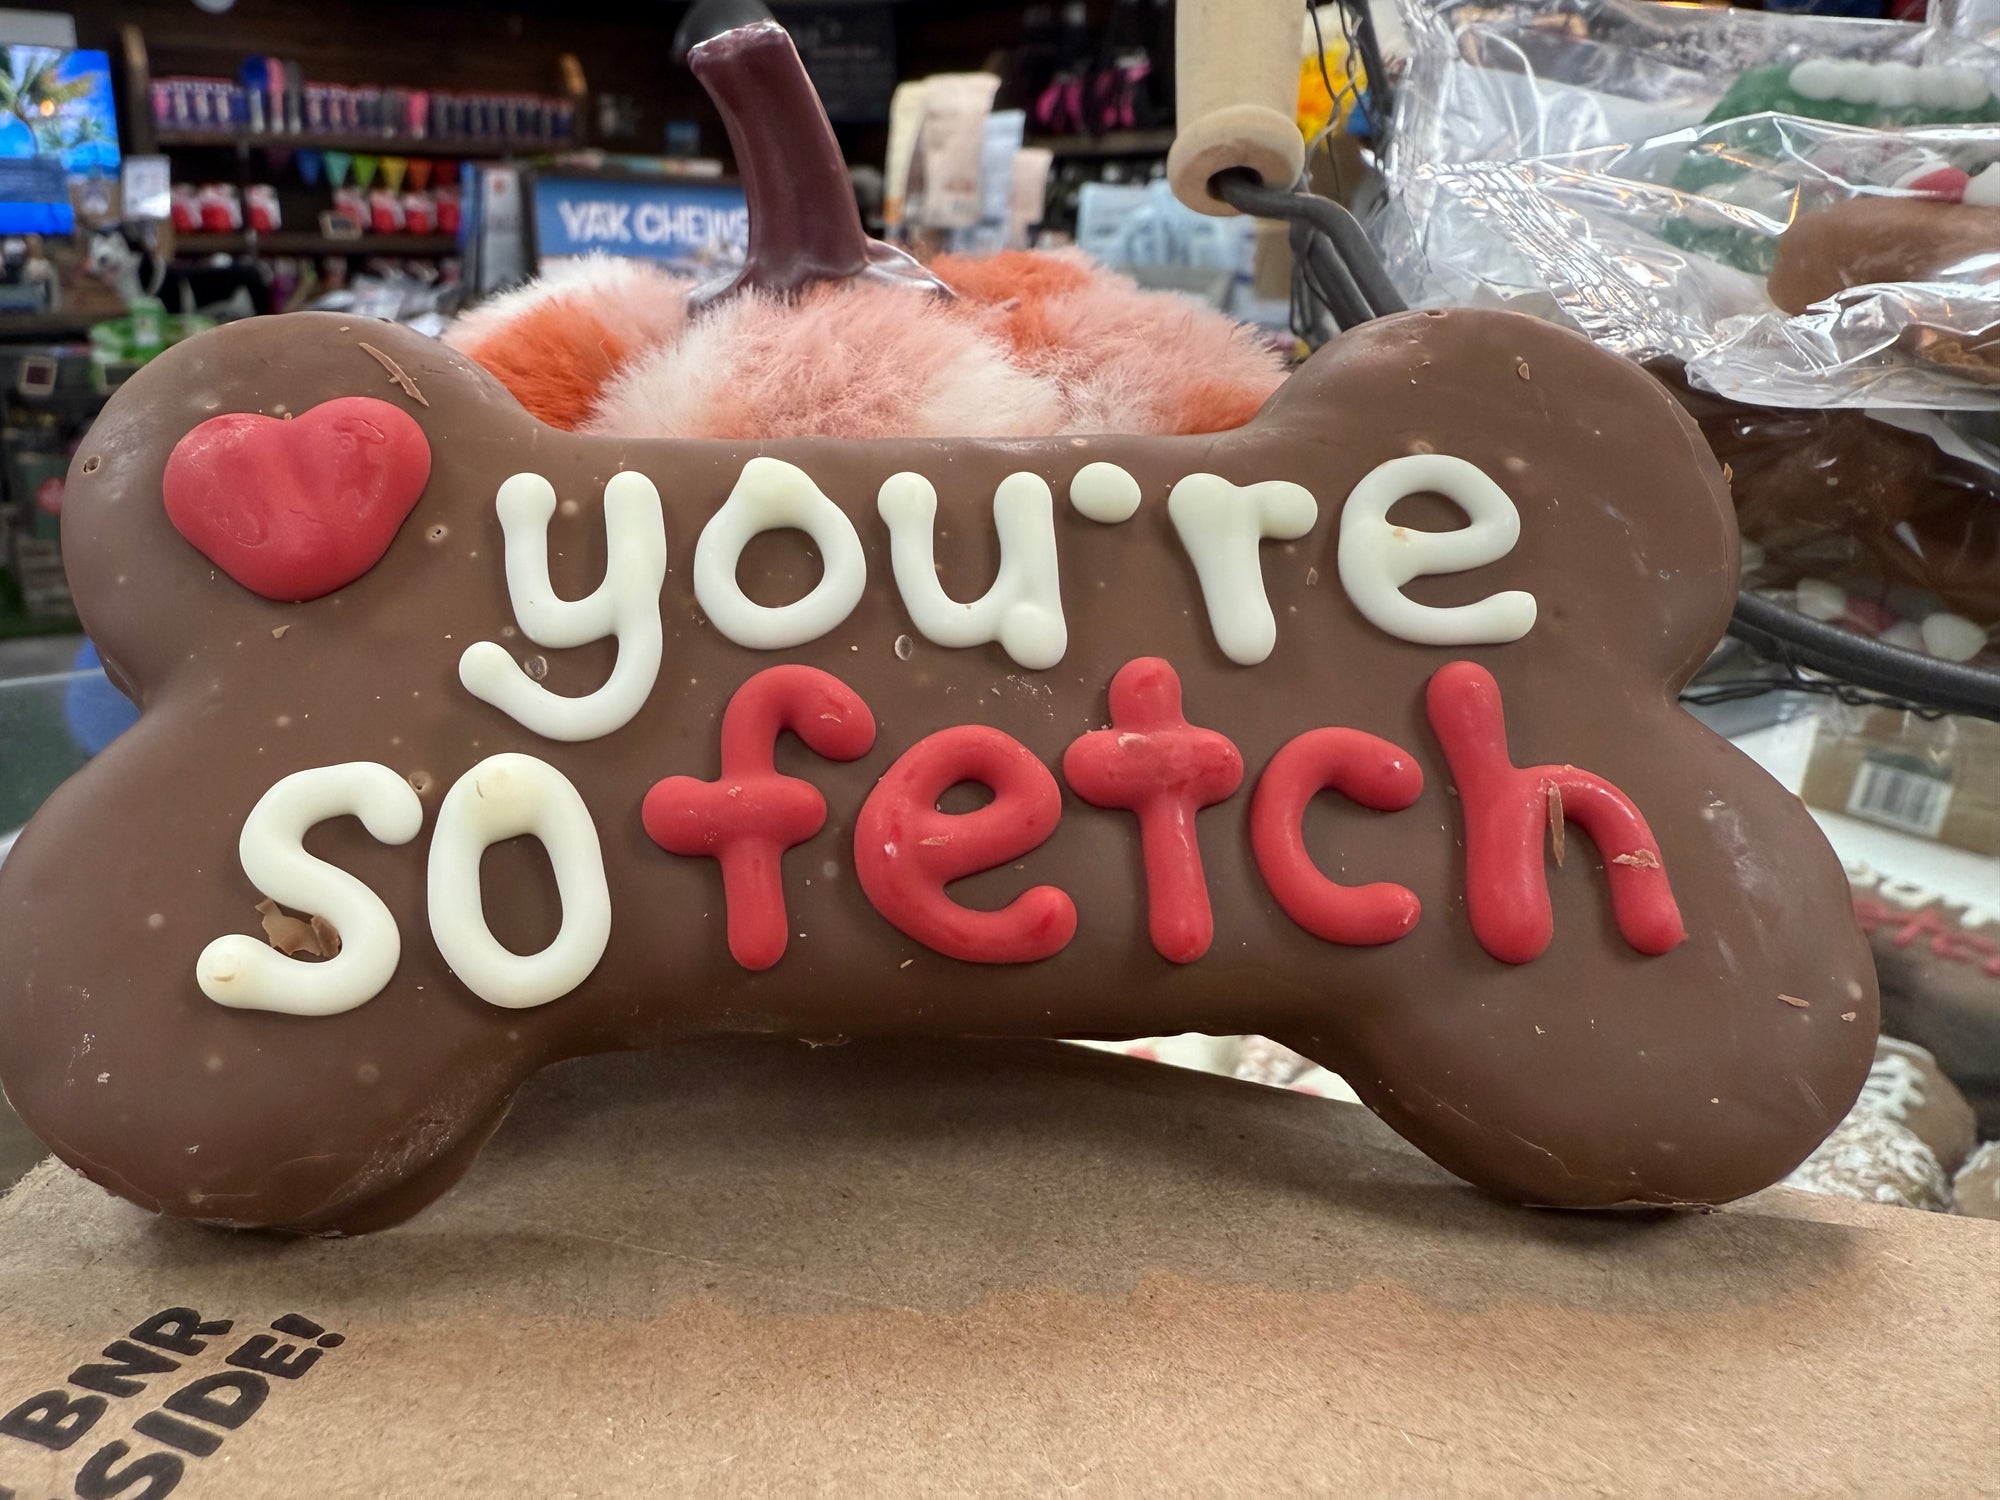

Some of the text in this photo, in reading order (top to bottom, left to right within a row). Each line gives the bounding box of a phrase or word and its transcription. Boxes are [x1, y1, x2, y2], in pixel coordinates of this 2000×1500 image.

[557, 200, 633, 243] YAK
[457, 455, 1539, 741] you're
[195, 657, 1686, 1016] so fetch
